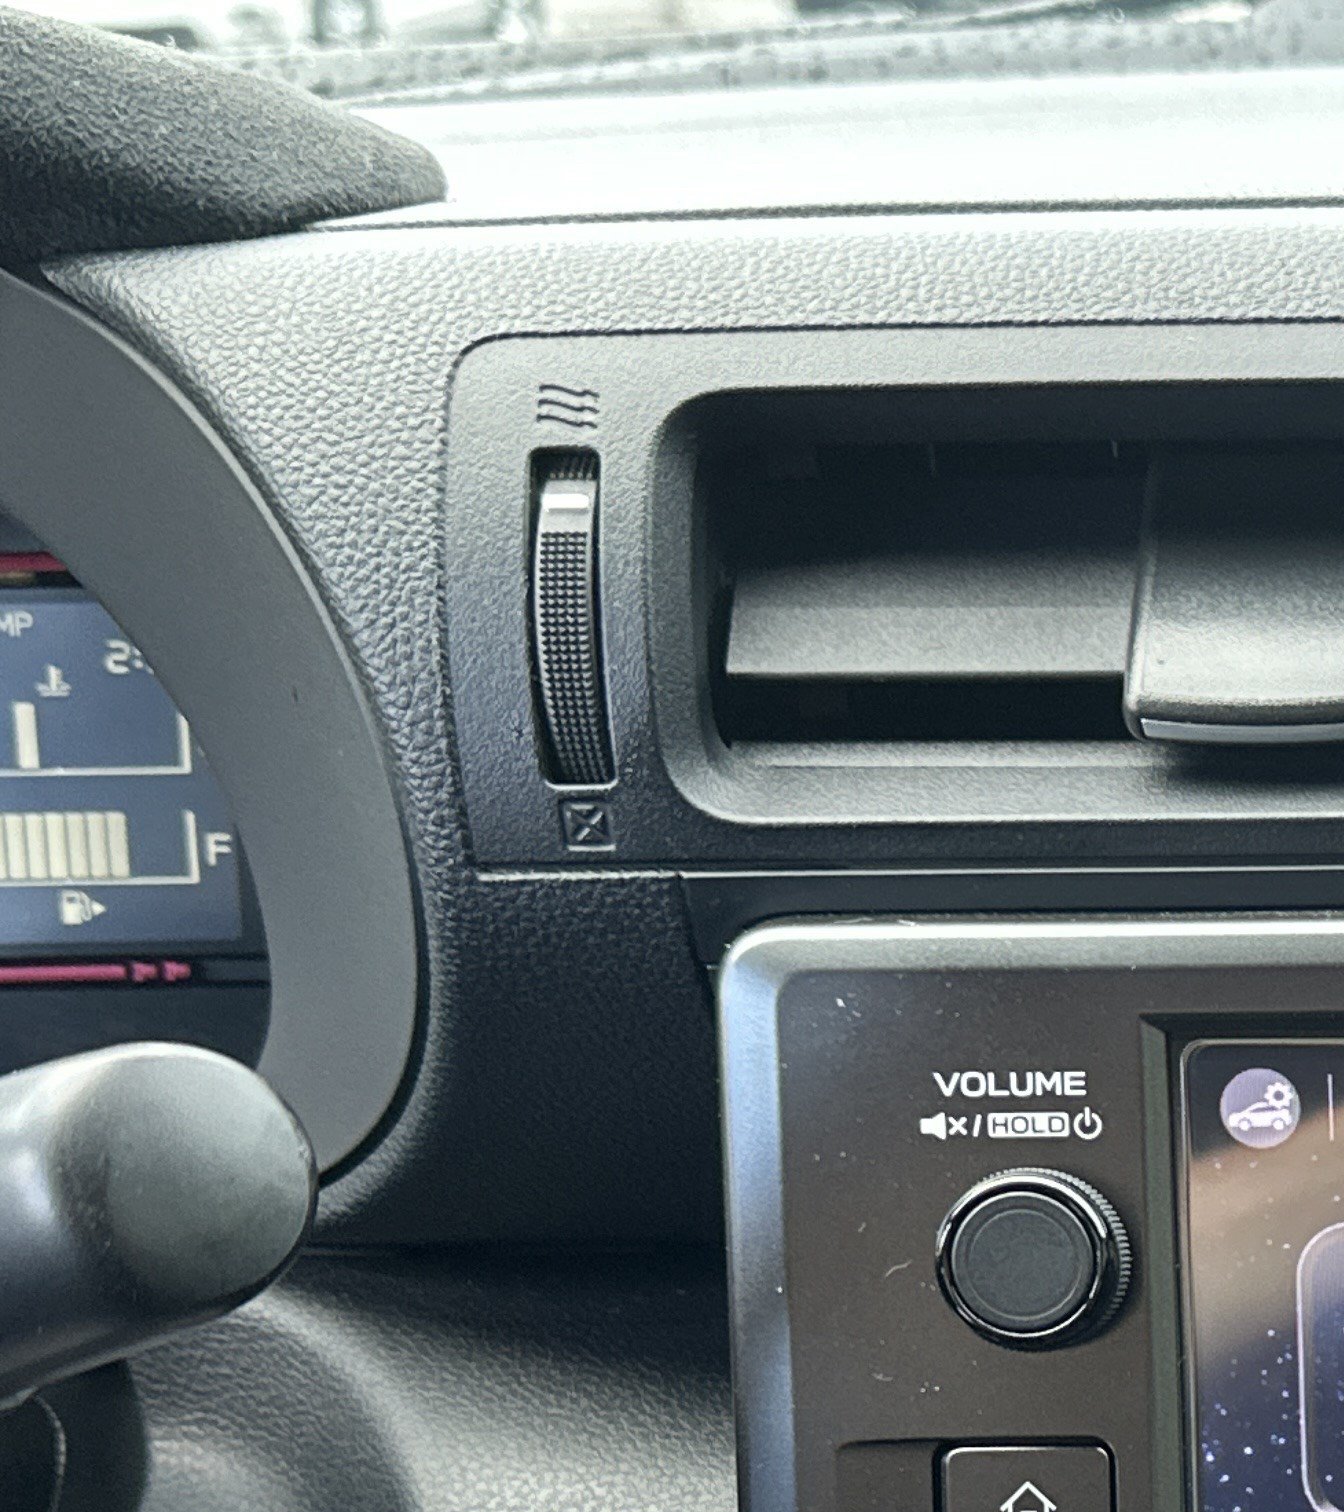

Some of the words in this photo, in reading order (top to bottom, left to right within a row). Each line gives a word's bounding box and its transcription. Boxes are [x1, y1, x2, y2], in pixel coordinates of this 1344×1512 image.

[205, 832, 231, 866] F
[932, 1070, 1087, 1098] VOLUME
[992, 1116, 1066, 1135] HOLD
